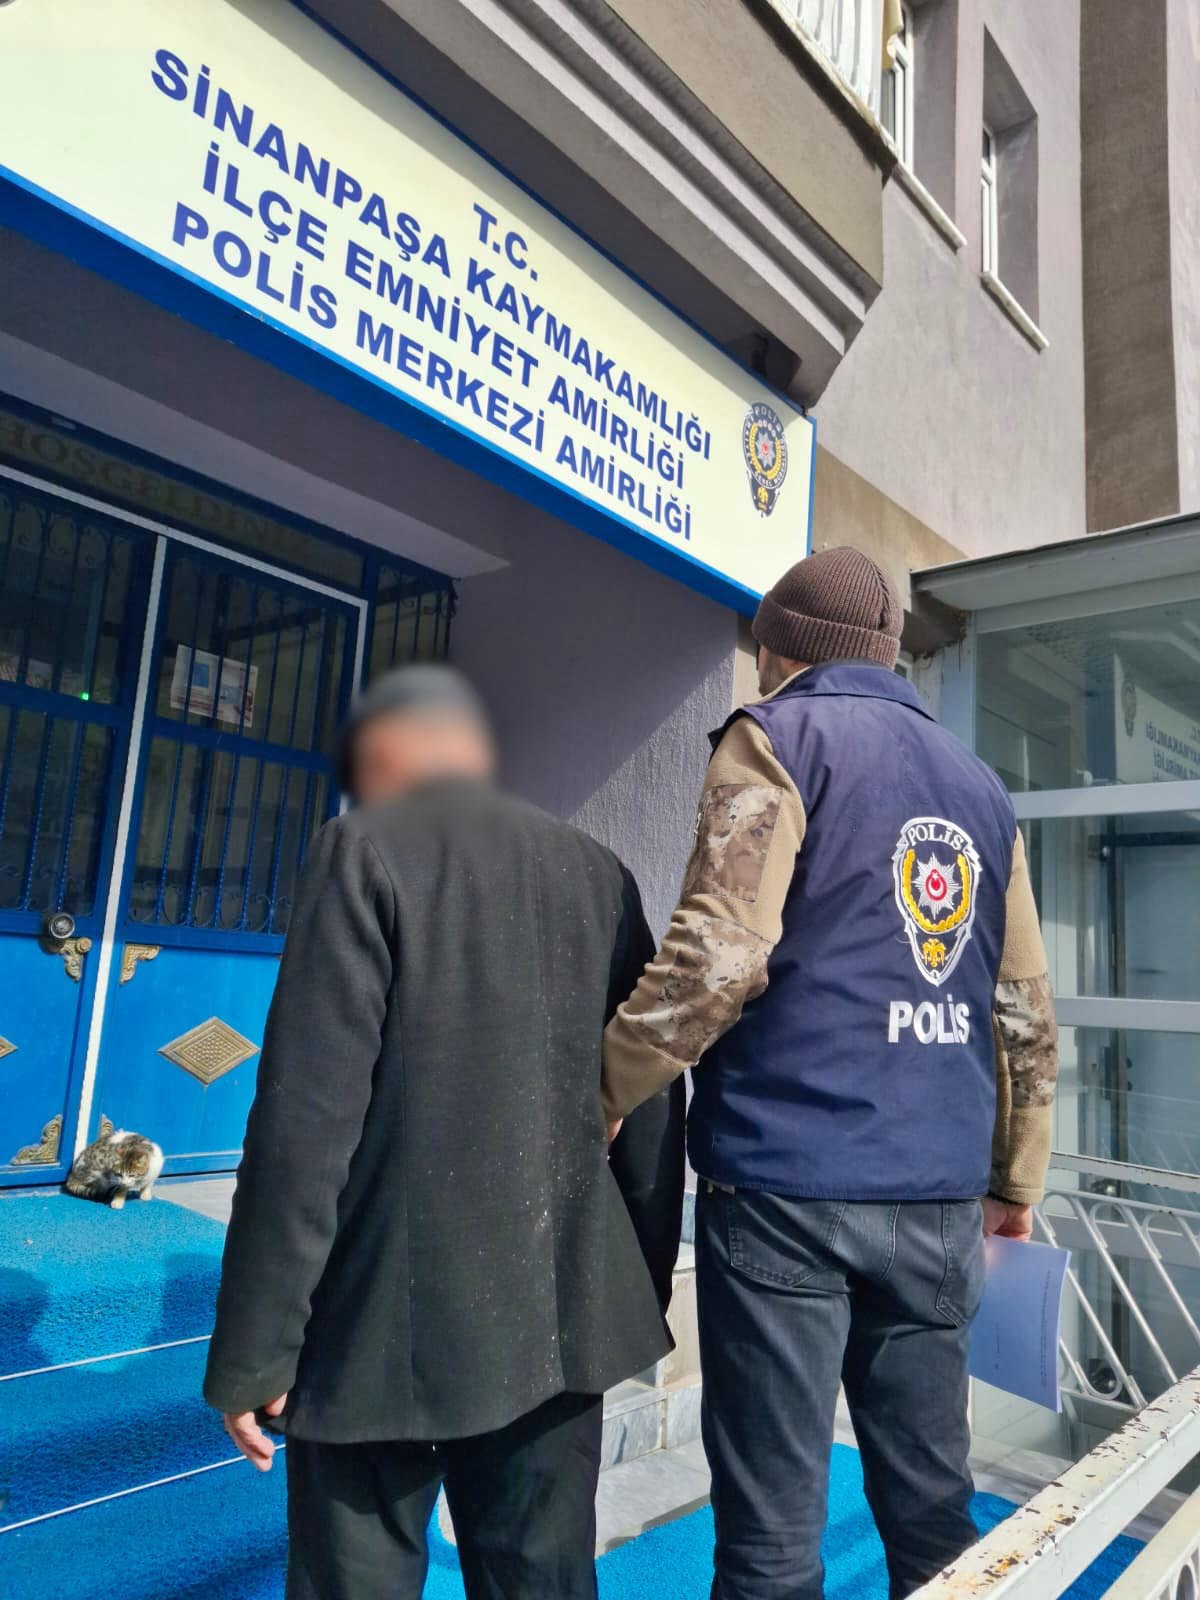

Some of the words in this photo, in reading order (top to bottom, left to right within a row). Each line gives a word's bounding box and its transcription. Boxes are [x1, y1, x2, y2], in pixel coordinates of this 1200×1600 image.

[151, 49, 451, 278] SİNANPAŞA
[467, 259, 711, 460] KAYMAKAMLIĞI
[202, 141, 328, 261] İLÇE
[345, 240, 539, 387] EMNİYET
[548, 375, 684, 488] AMİRLİĞİ
[473, 203, 538, 280] T.C.
[172, 201, 337, 329] POLİS
[356, 311, 545, 452] MERKEZİ
[556, 435, 691, 540] AMİRLİĞİ
[907, 823, 965, 851] POLİS
[888, 994, 970, 1044] POLİS
